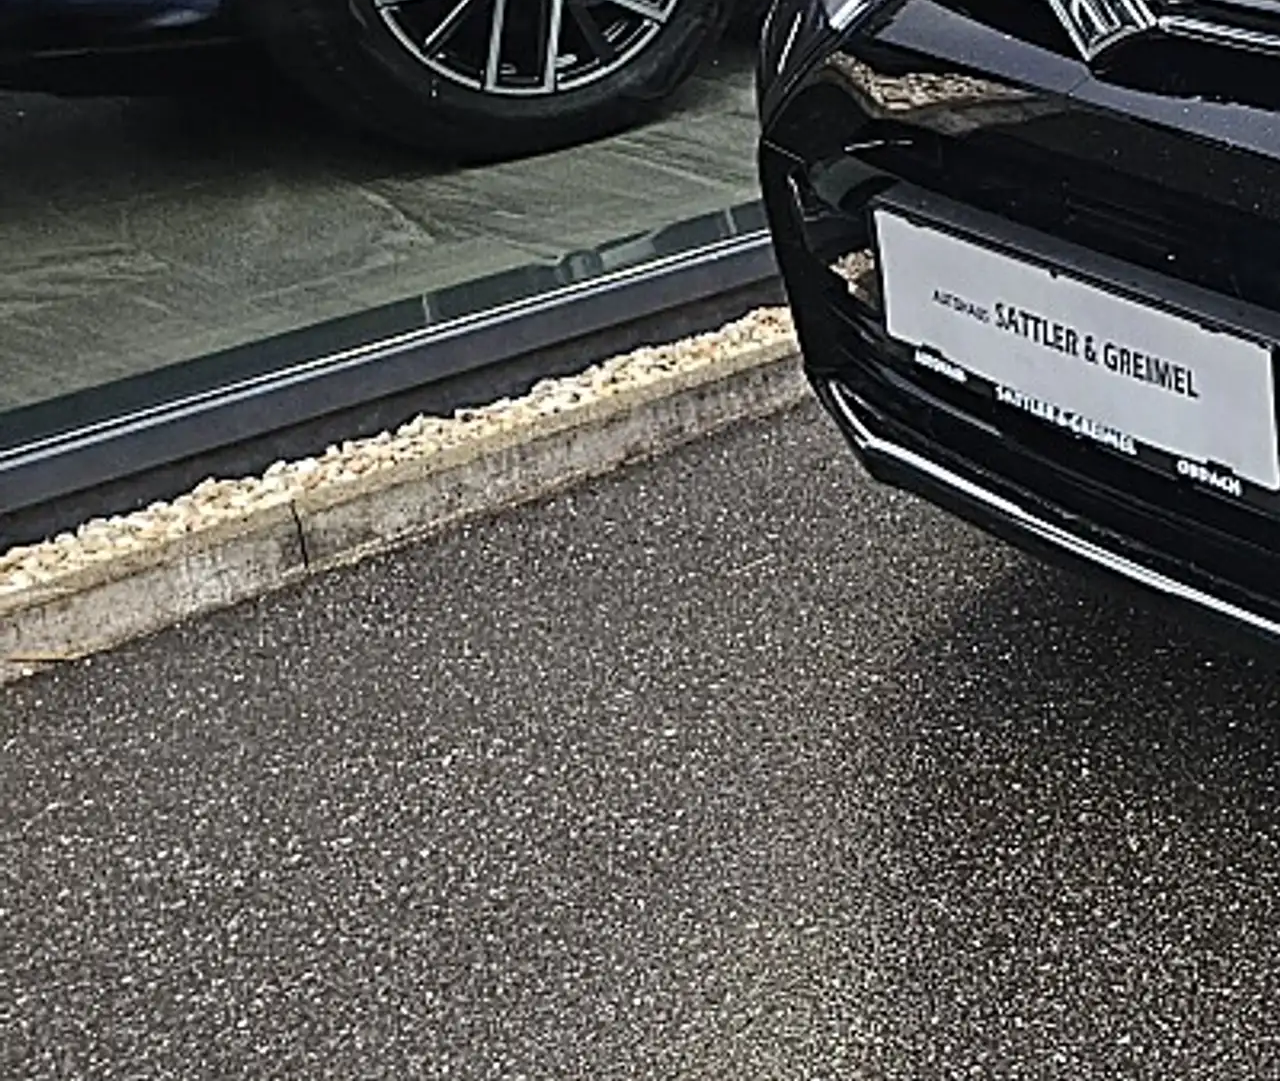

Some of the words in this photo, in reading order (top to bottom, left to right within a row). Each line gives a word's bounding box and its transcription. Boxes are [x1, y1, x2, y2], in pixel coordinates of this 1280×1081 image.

[994, 302, 1078, 357] SATTLER
[1084, 335, 1100, 365] &
[1103, 341, 1199, 398] GREIMEL
